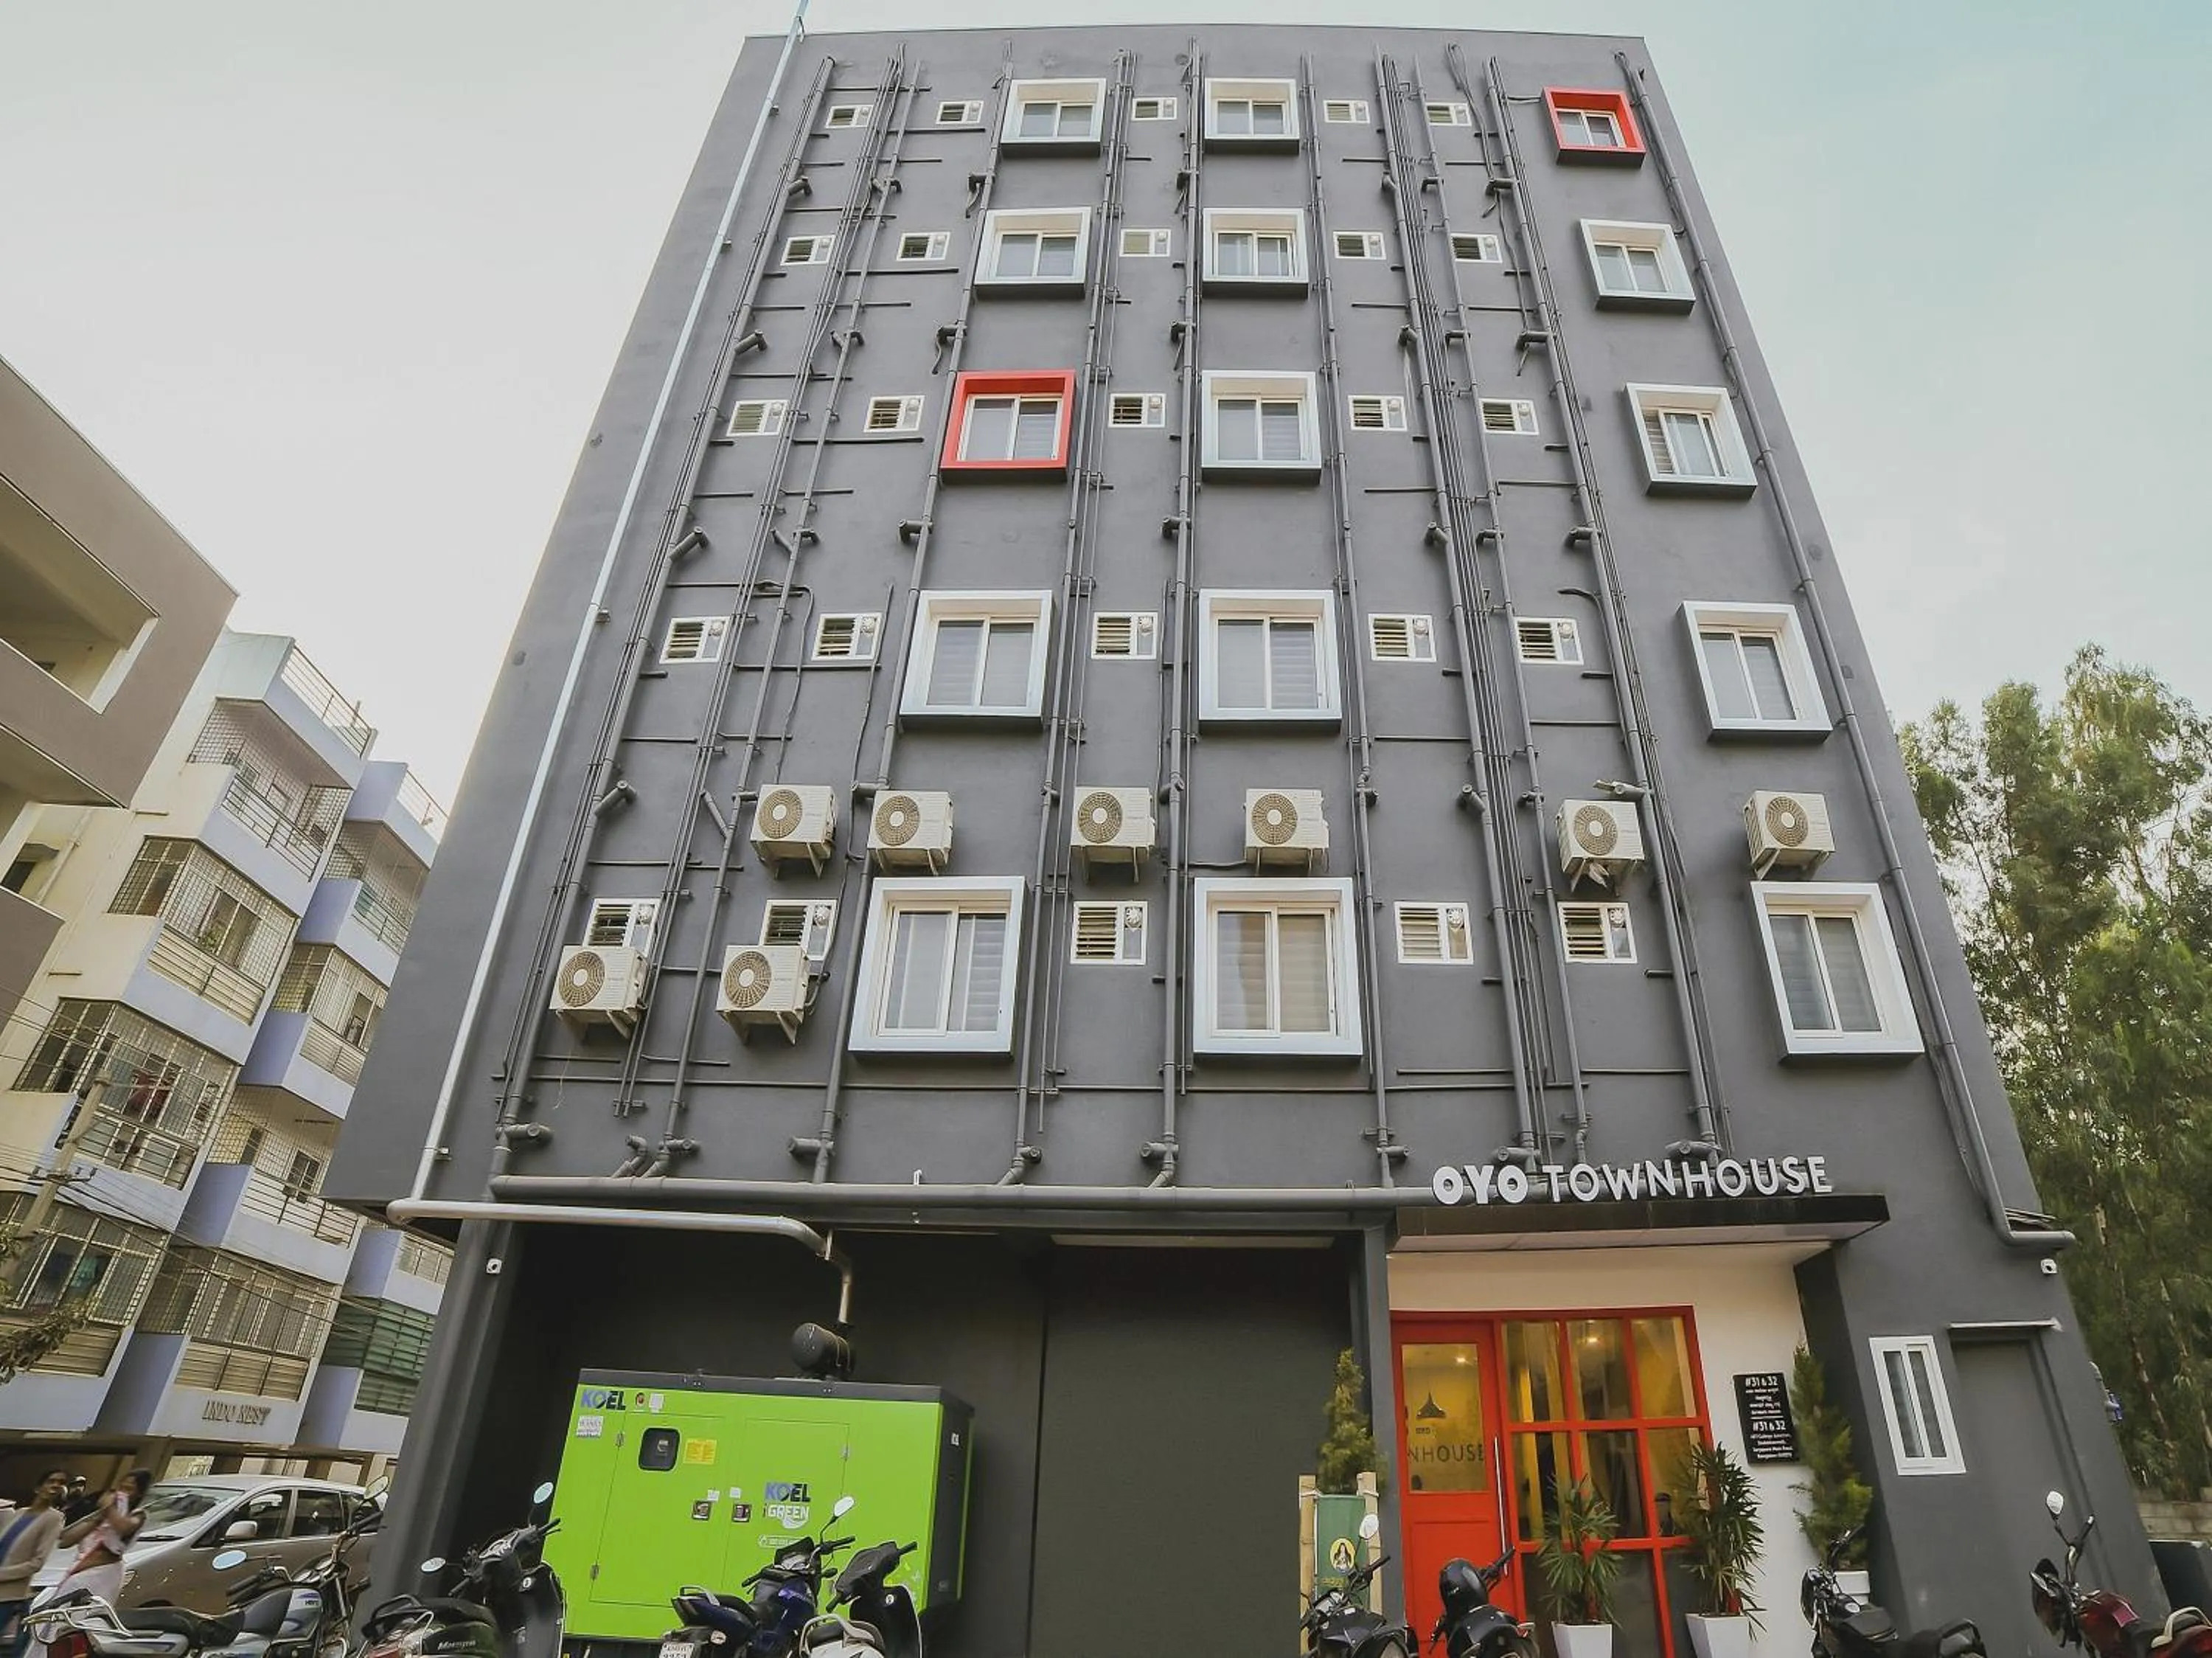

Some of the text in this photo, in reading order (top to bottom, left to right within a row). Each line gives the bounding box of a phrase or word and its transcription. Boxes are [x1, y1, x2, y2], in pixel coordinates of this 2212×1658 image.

[1432, 1156, 1833, 1205] OYO TOWNHOUSE
[581, 1390, 626, 1410] KOEL
[765, 1482, 810, 1502] KOEL
